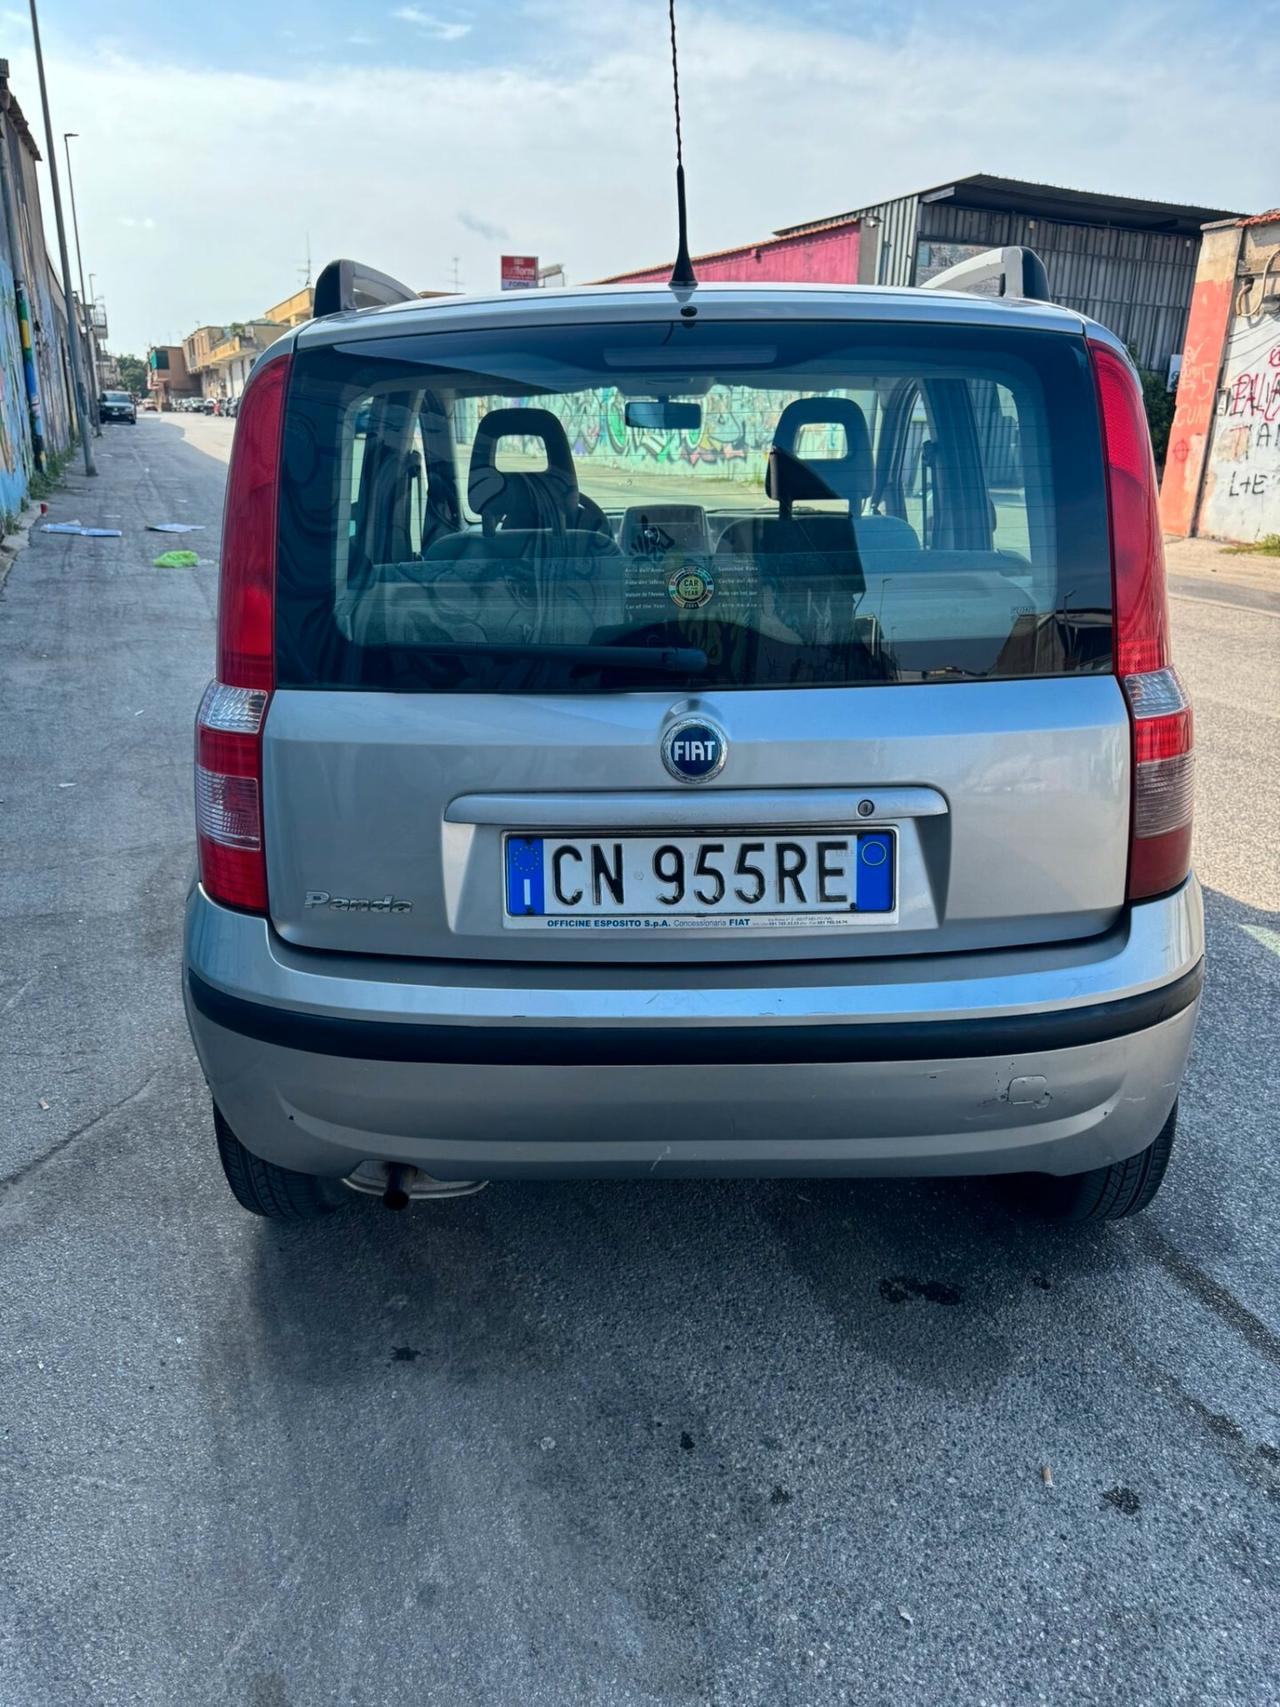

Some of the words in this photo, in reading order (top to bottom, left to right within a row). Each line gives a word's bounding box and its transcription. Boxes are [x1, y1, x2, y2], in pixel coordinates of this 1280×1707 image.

[683, 579, 699, 587] CAR
[673, 741, 717, 761] FIAT
[552, 843, 625, 905] CN
[652, 841, 849, 905] 955RE
[303, 890, 413, 914] Panda
[547, 919, 592, 928] OFFICINE
[593, 919, 642, 928] ESPOSITO
[643, 919, 671, 928] S.p.A.
[729, 918, 751, 927] FIAT
